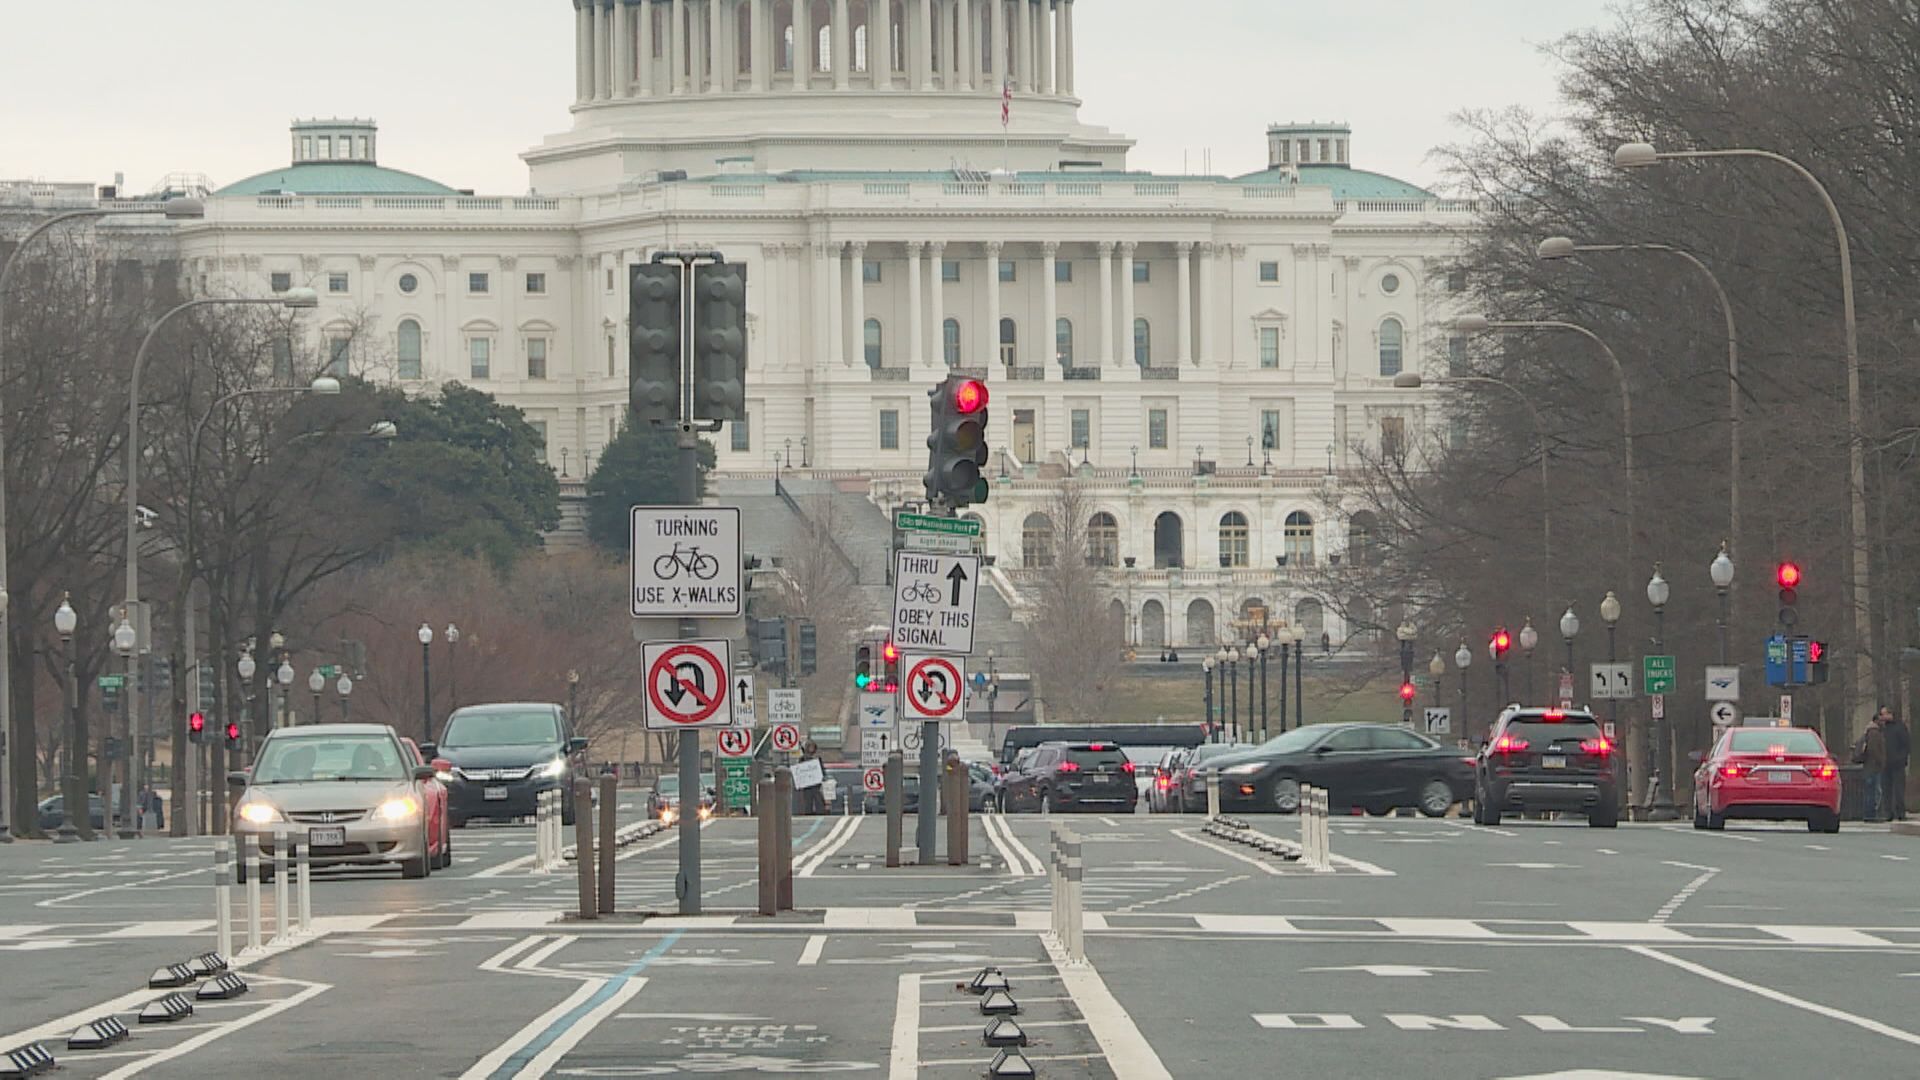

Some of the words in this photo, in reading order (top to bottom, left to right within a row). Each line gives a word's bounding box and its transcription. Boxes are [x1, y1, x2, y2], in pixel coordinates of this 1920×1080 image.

[656, 519, 718, 536] TURNING
[902, 557, 938, 574] THRU
[636, 587, 665, 604] USE
[672, 587, 736, 604] X-WALKS
[899, 609, 934, 626] OBEY
[940, 611, 969, 628] THIS
[897, 627, 946, 646] SIGNAL
[1652, 660, 1665, 668] ALL
[1647, 669, 1673, 678] TRUCKS
[1249, 1013, 1717, 1033] ONLY
